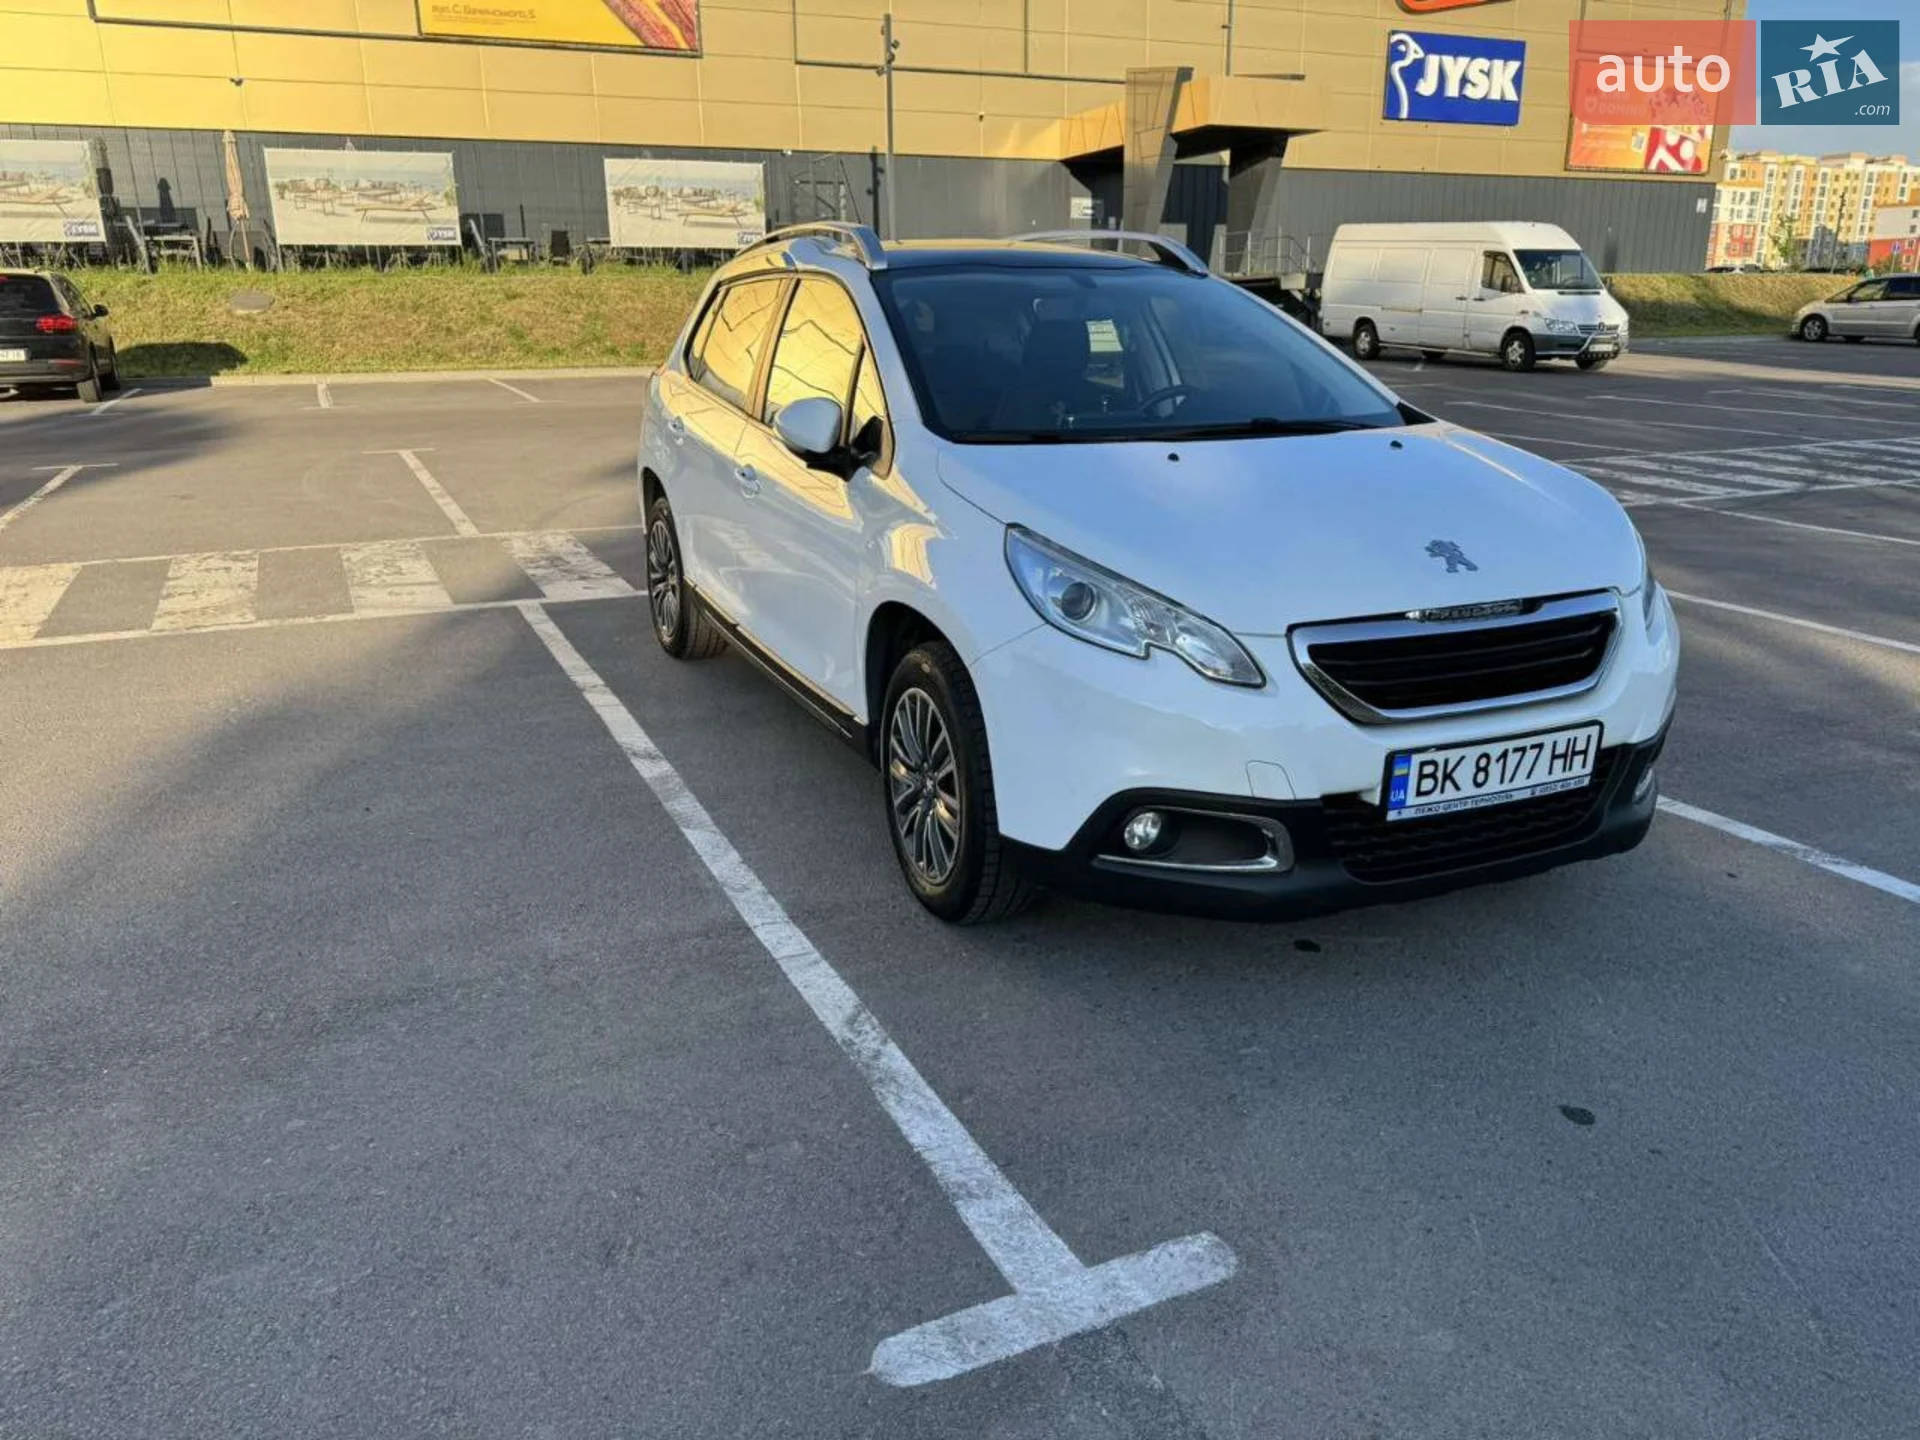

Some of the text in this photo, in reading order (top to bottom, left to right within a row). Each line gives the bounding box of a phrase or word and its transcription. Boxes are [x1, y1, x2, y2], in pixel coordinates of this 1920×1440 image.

[1415, 54, 1521, 101] JYSK
[1416, 735, 1592, 797] BK 8177 HH
[1391, 789, 1405, 802] UA
